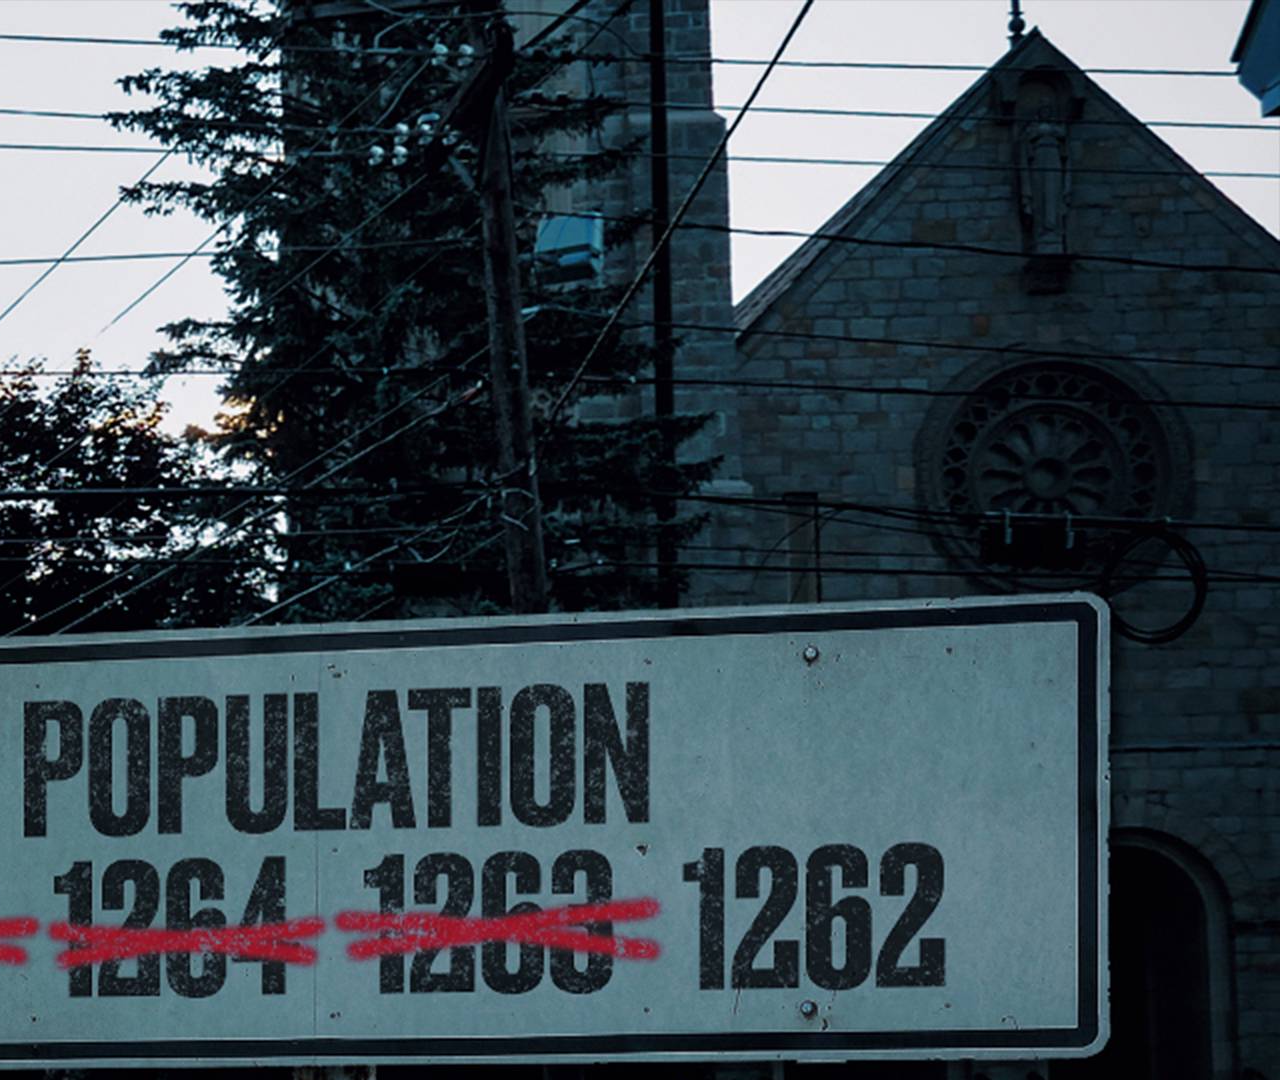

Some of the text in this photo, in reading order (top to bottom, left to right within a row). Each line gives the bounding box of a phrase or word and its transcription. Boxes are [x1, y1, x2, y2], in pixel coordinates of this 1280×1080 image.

[23, 681, 651, 838] POPULATION
[53, 856, 288, 998] 1264
[363, 848, 614, 995] 1263
[683, 842, 947, 991] 1262
